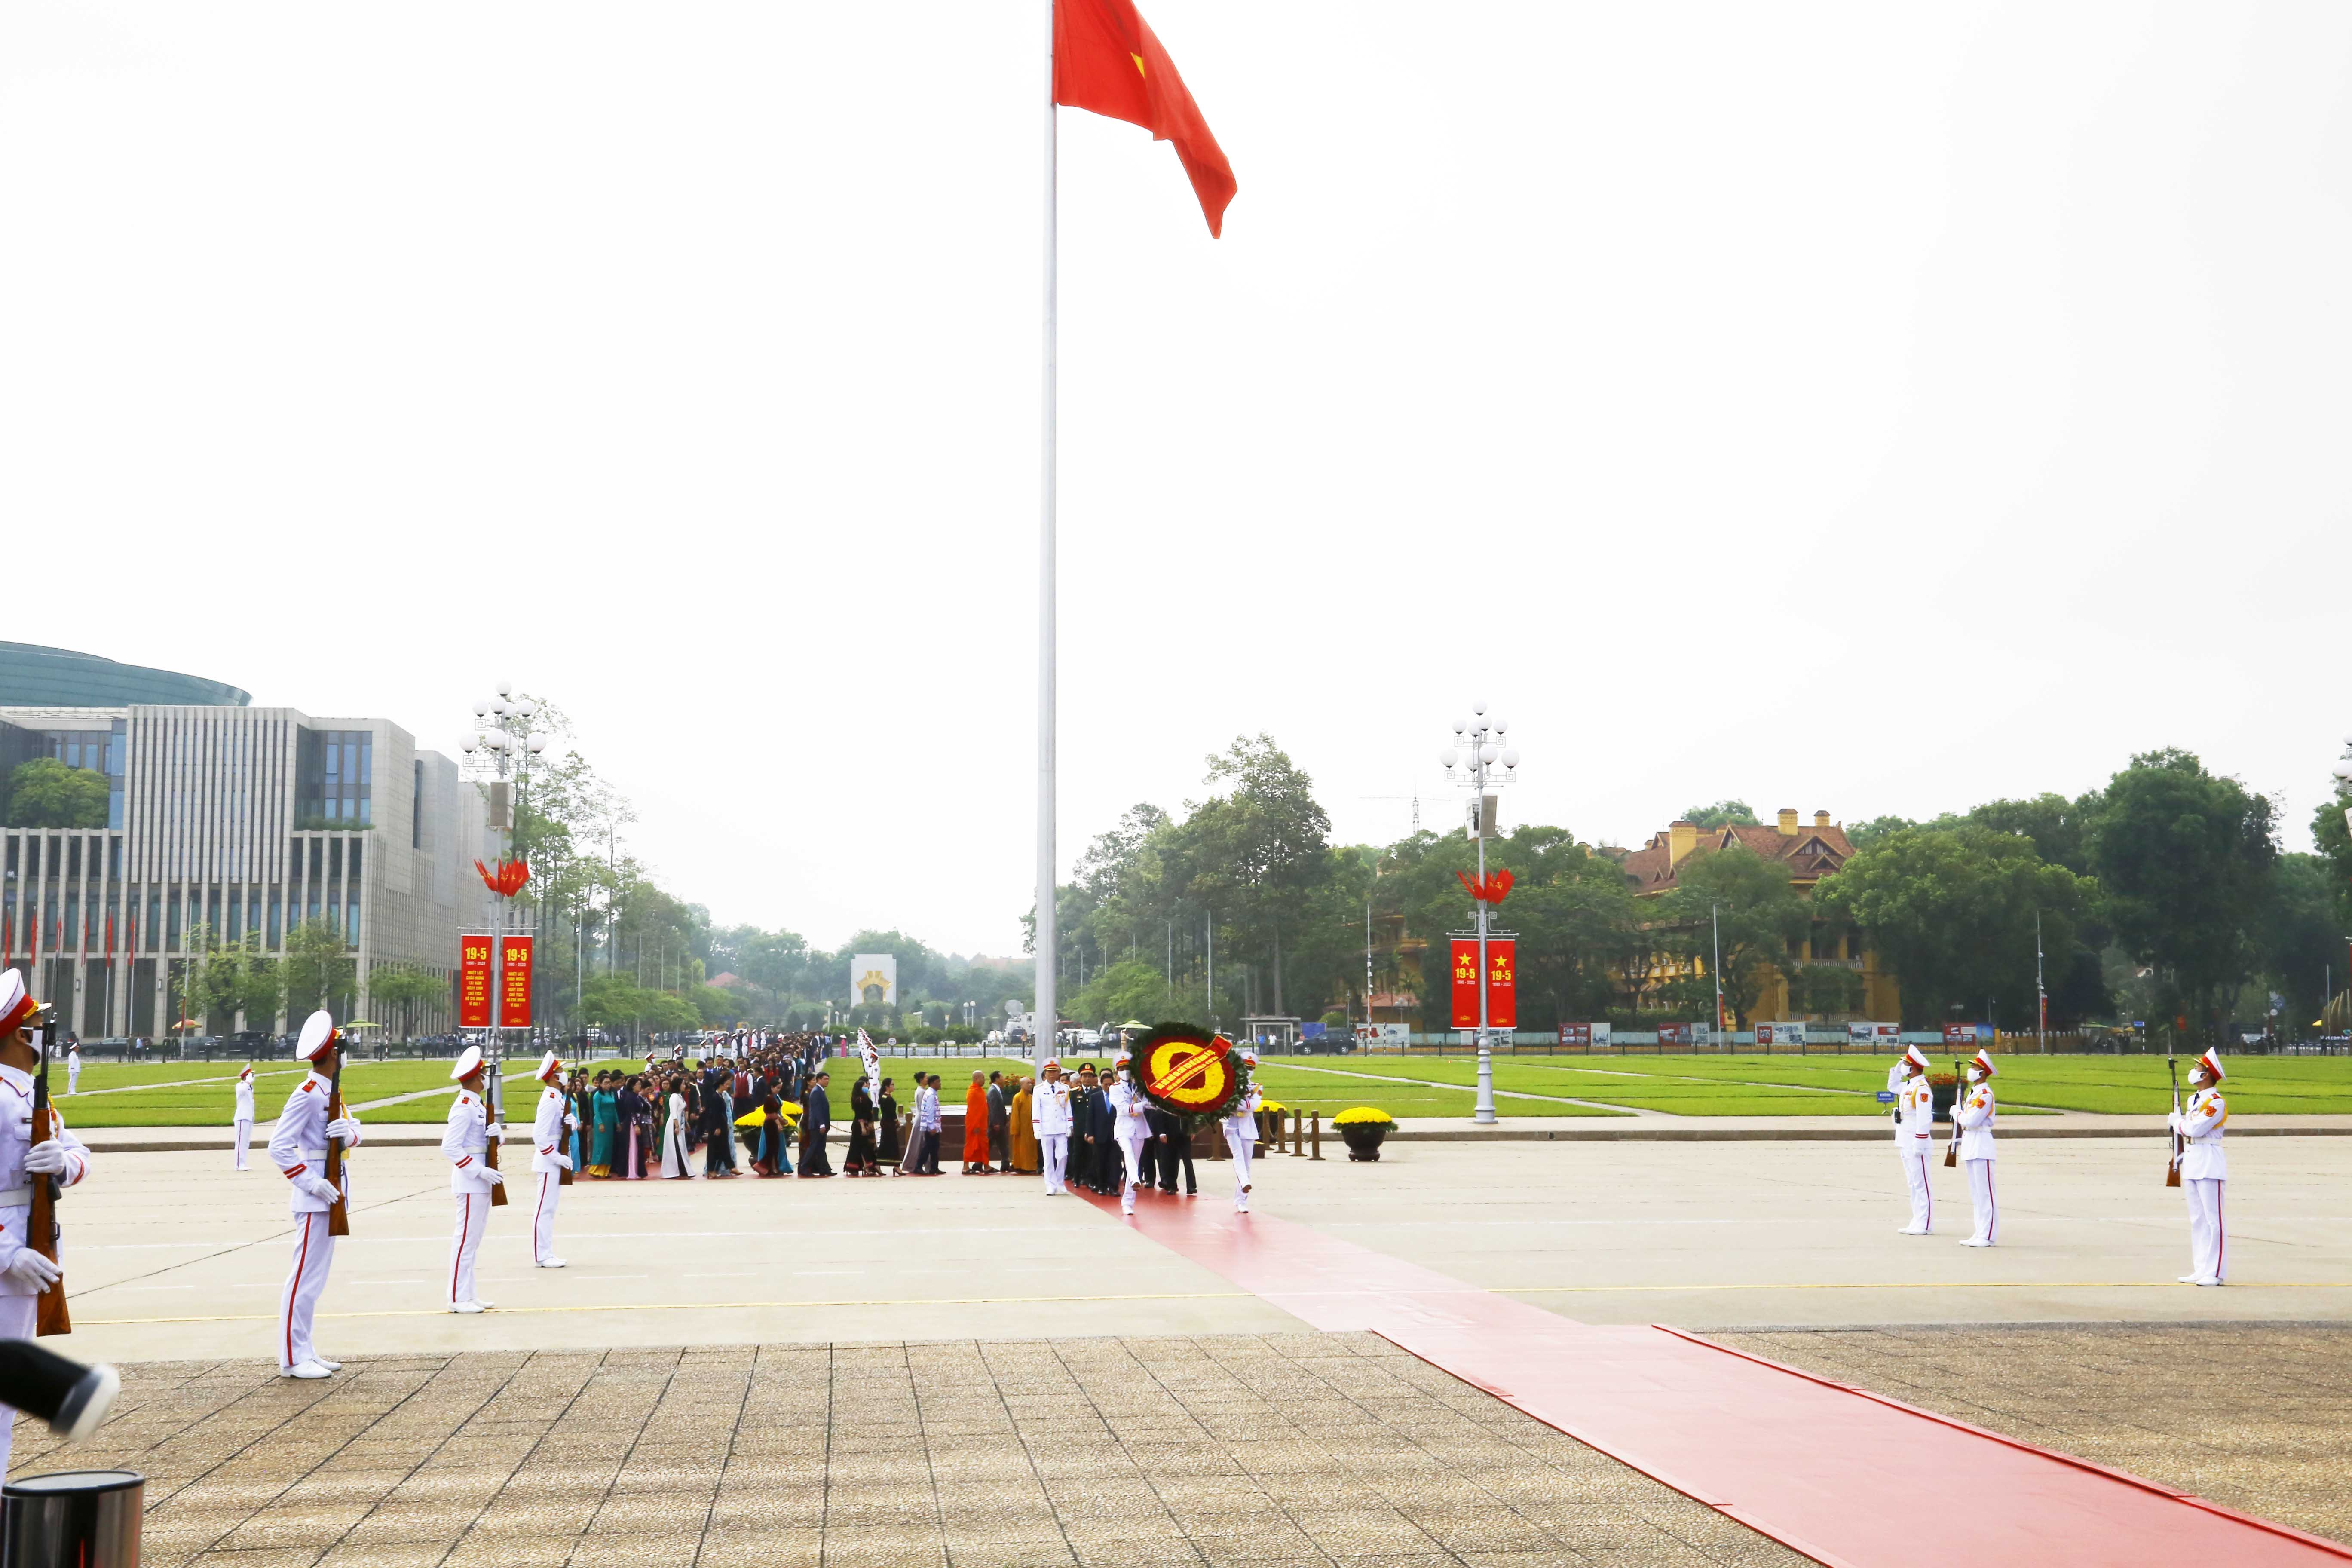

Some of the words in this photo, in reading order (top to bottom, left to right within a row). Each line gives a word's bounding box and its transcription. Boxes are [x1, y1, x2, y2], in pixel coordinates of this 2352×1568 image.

[466, 947, 487, 960] 19-5
[506, 949, 527, 962] 19-5
[1455, 968, 1476, 979] 19-5
[1491, 970, 1511, 980] 19-5
